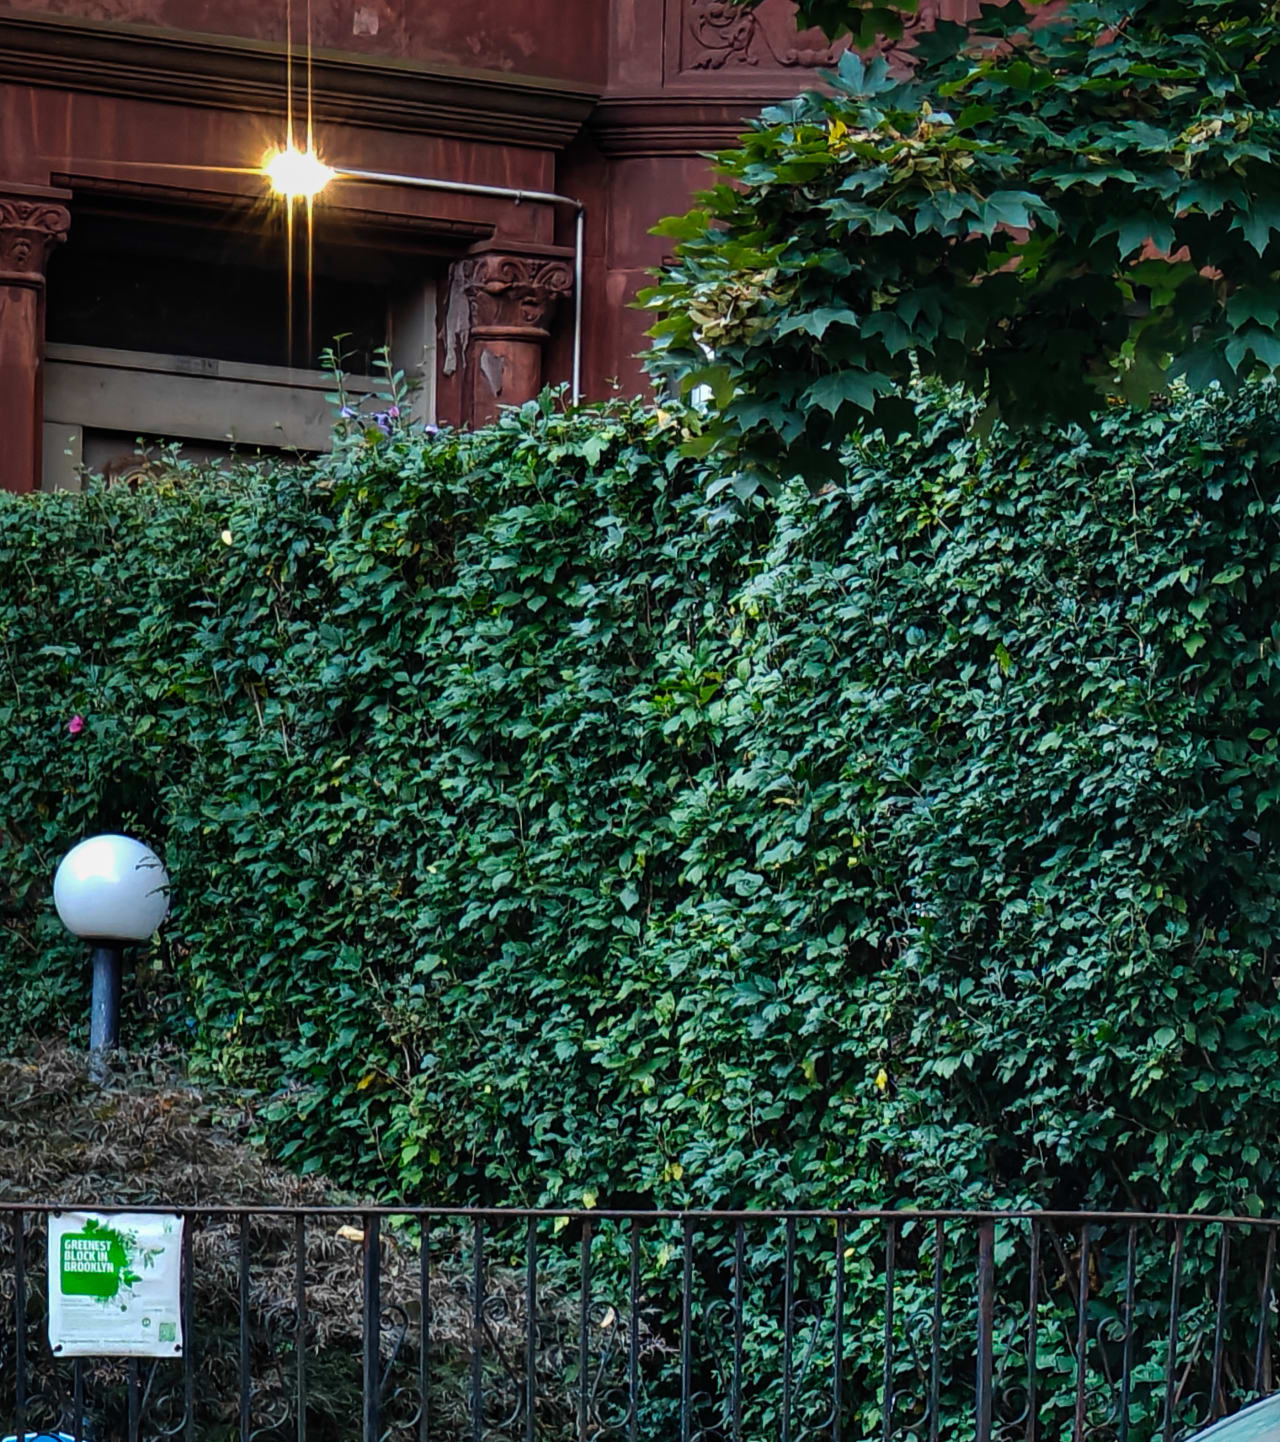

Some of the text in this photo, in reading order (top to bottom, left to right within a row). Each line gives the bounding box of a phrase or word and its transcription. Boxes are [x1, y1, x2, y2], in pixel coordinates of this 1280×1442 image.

[64, 1239, 112, 1251] GREENEST
[64, 1250, 108, 1262] BLOCK IN
[64, 1261, 114, 1273] BROOKLYN
